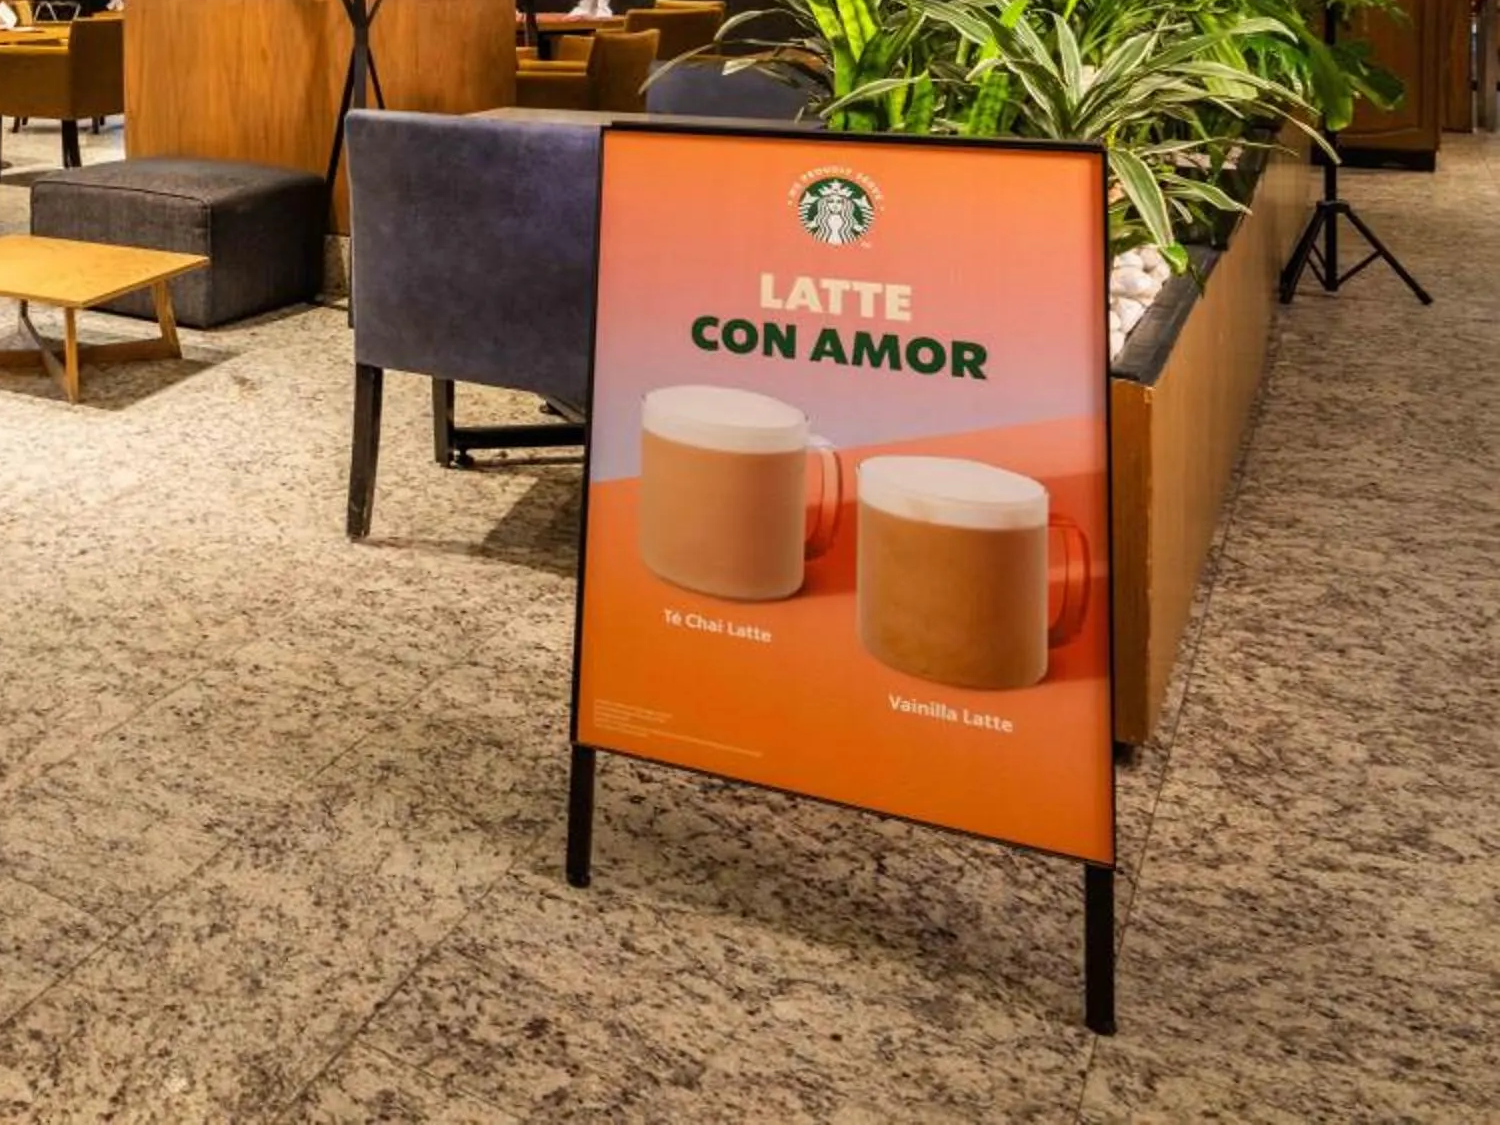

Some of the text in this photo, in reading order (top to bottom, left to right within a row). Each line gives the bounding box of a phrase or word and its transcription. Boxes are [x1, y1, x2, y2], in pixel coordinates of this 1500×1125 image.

[760, 273, 913, 321] LATTE
[691, 315, 988, 380] CON AMOR
[664, 608, 772, 643] Té Chai Latte
[888, 693, 1014, 733] Vainilla Latte
